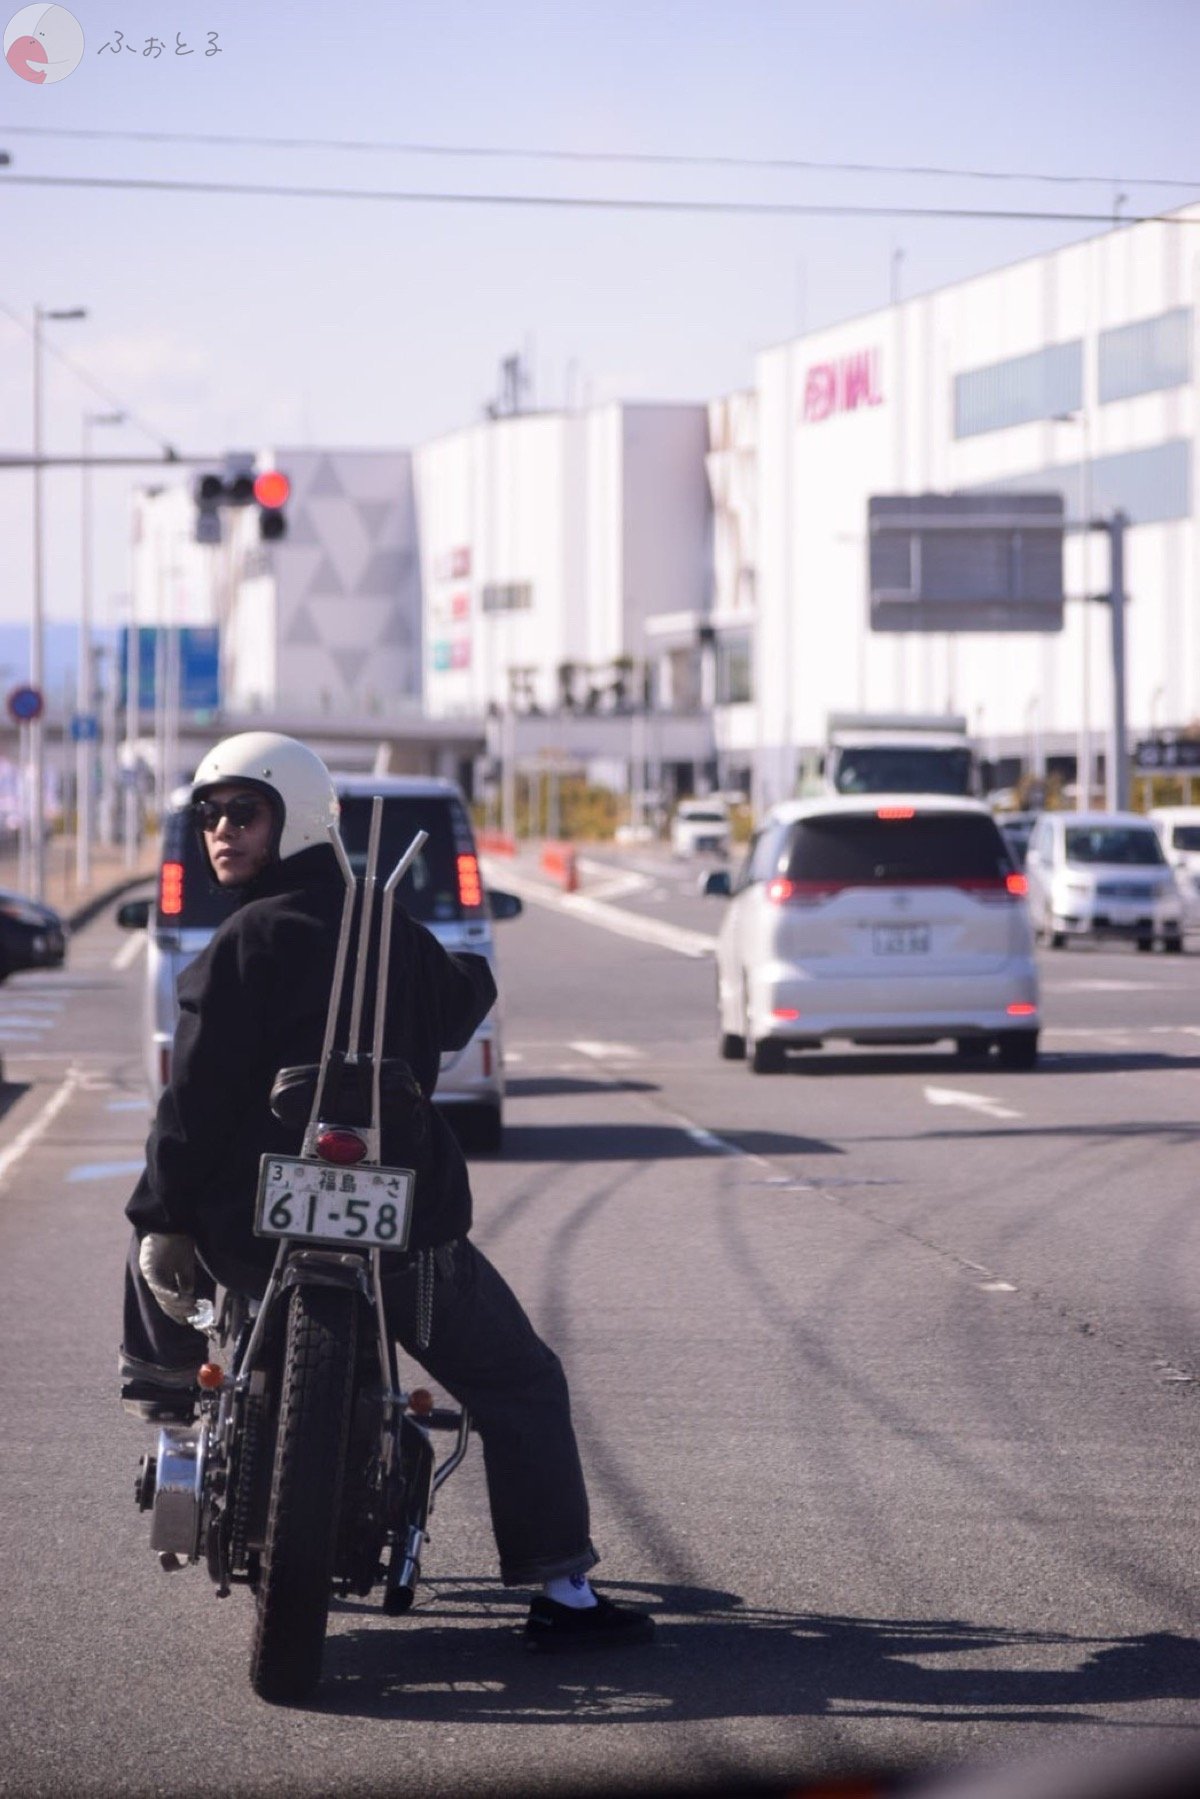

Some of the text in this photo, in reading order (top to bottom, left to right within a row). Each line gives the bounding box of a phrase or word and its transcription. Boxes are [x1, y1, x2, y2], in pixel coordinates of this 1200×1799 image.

[272, 1165, 283, 1181] 3
[319, 1168, 356, 1193] 福島
[269, 1192, 397, 1240] 61-58
